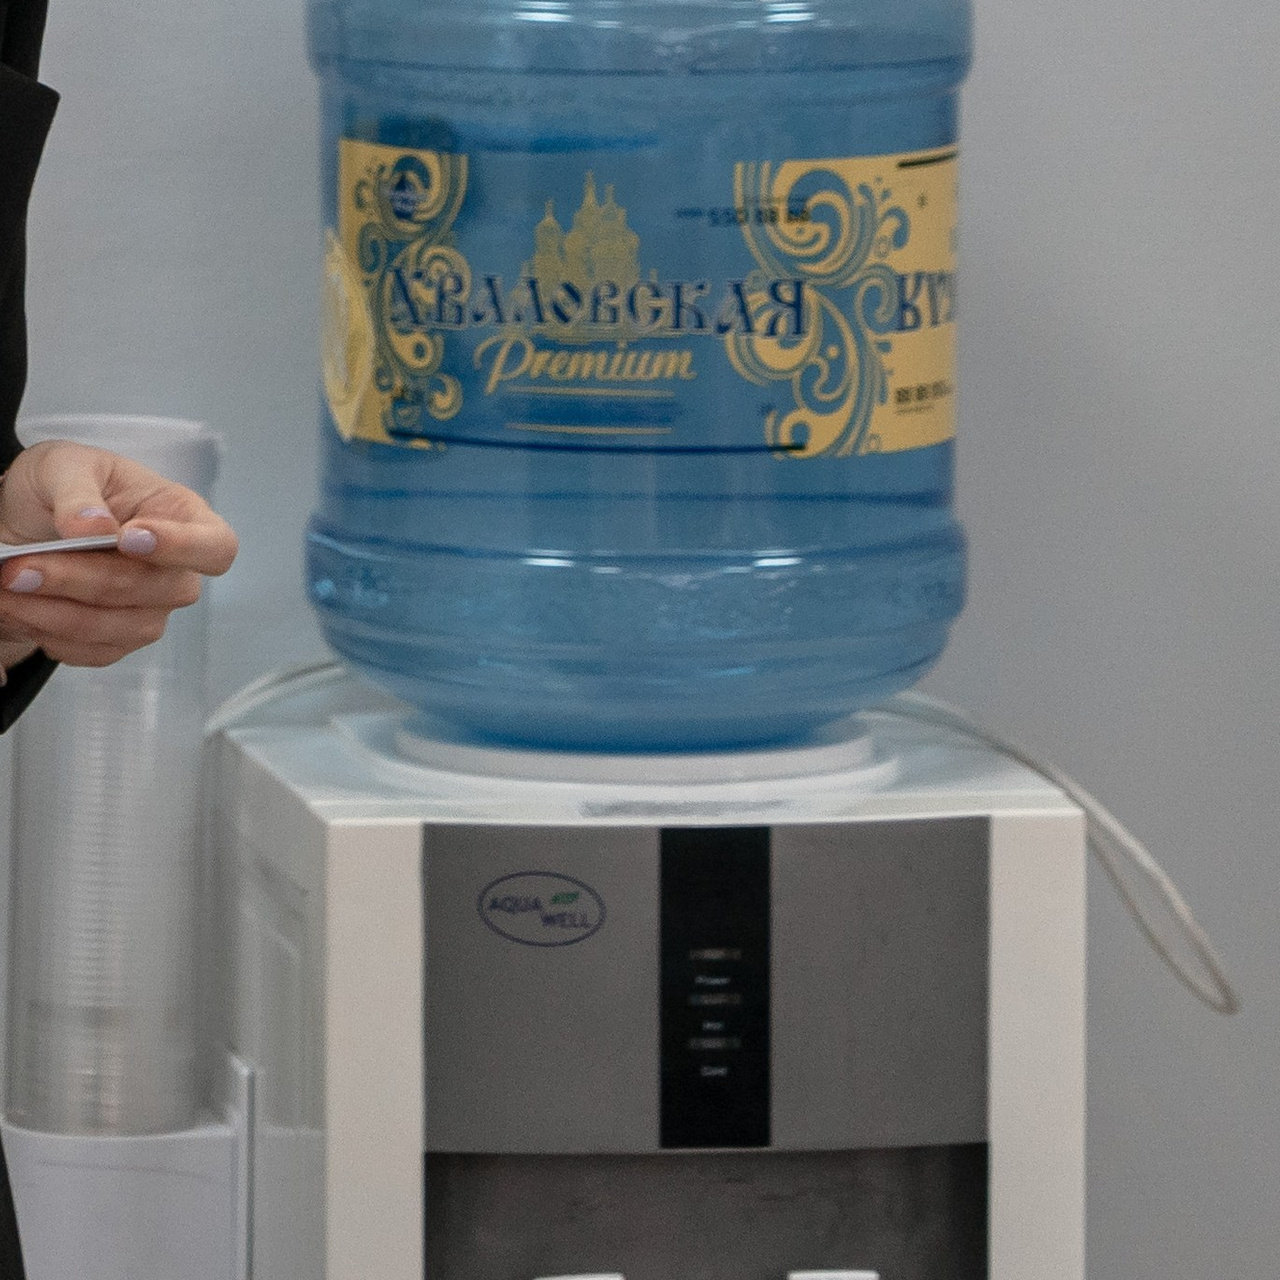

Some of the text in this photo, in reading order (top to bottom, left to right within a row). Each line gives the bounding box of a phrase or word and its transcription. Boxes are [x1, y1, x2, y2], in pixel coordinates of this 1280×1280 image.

[474, 332, 698, 397] Premium
[487, 896, 543, 915] AQUA
[541, 912, 594, 928] WELL
